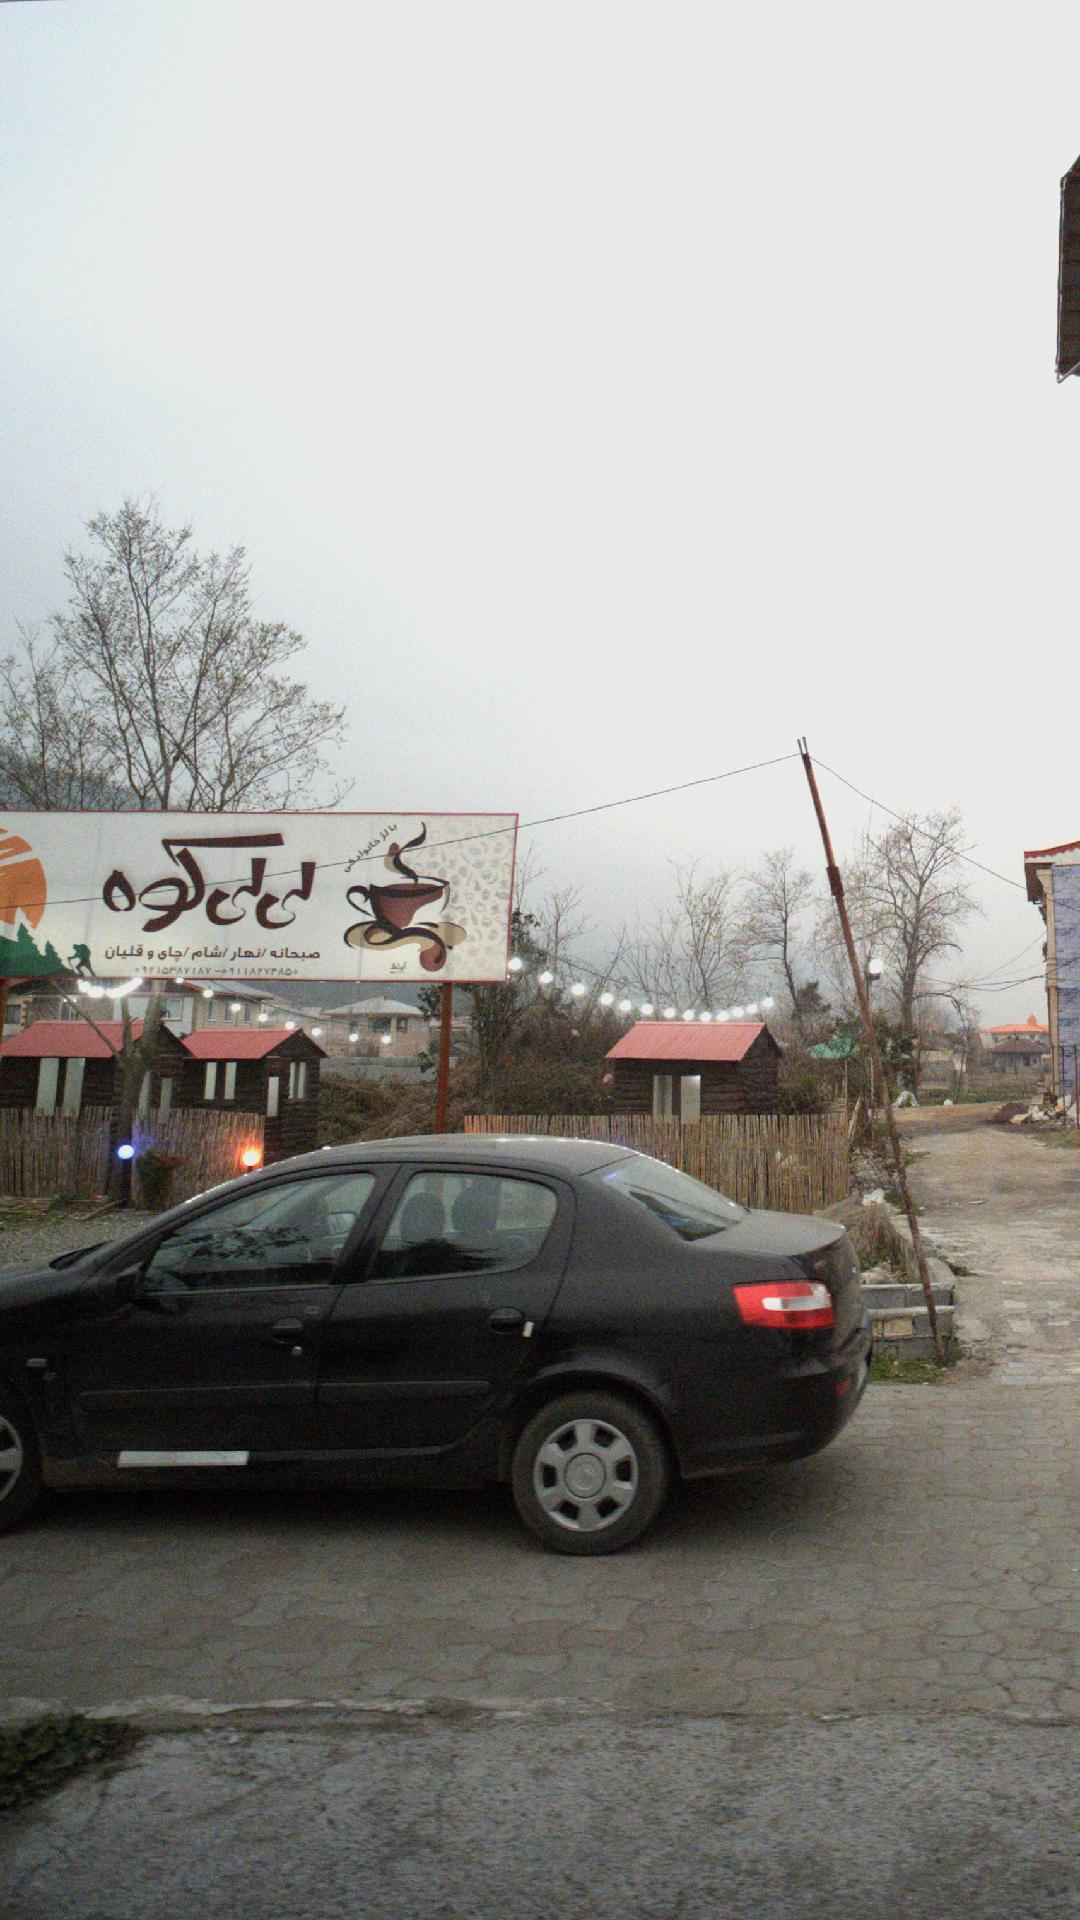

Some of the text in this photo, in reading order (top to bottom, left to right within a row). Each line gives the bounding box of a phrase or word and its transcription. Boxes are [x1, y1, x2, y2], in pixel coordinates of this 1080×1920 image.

[102, 832, 286, 933] کوه
[104, 943, 144, 960] قلیان
[146, 949, 154, 960] و
[270, 946, 321, 962] صبحانه
